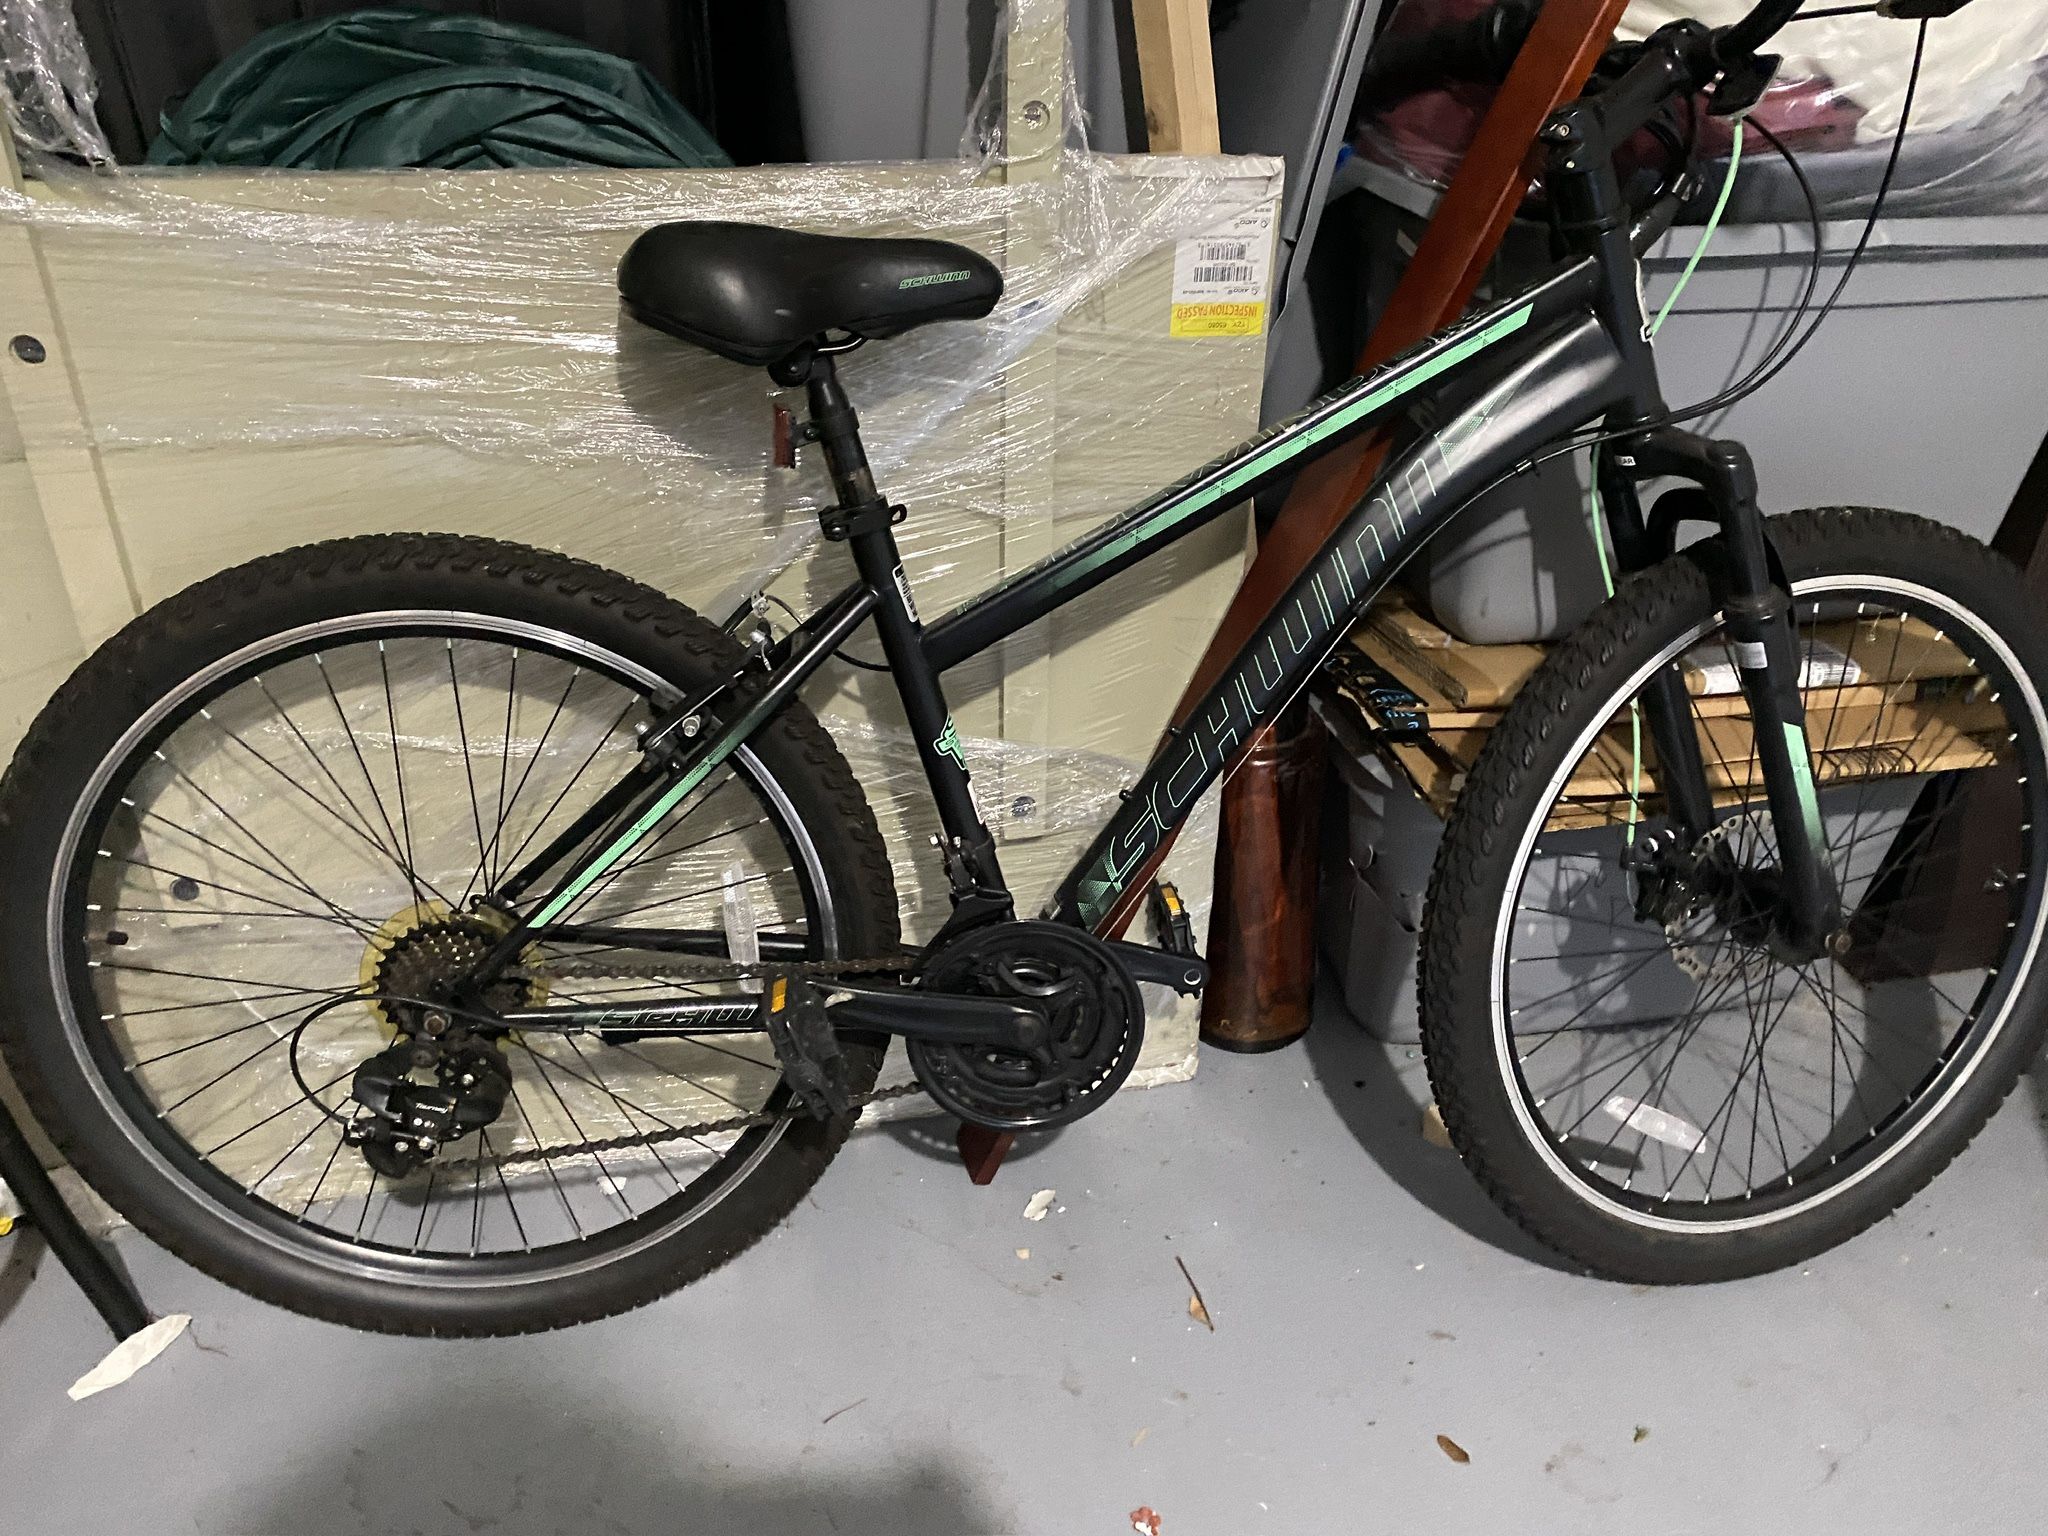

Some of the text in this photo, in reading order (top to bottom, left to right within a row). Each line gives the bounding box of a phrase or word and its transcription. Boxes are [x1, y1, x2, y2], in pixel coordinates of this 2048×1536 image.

[898, 270, 971, 290] SCHWINN
[1176, 304, 1258, 319] INSPECTION PASSED
[1108, 433, 1453, 893] SCHWINN
